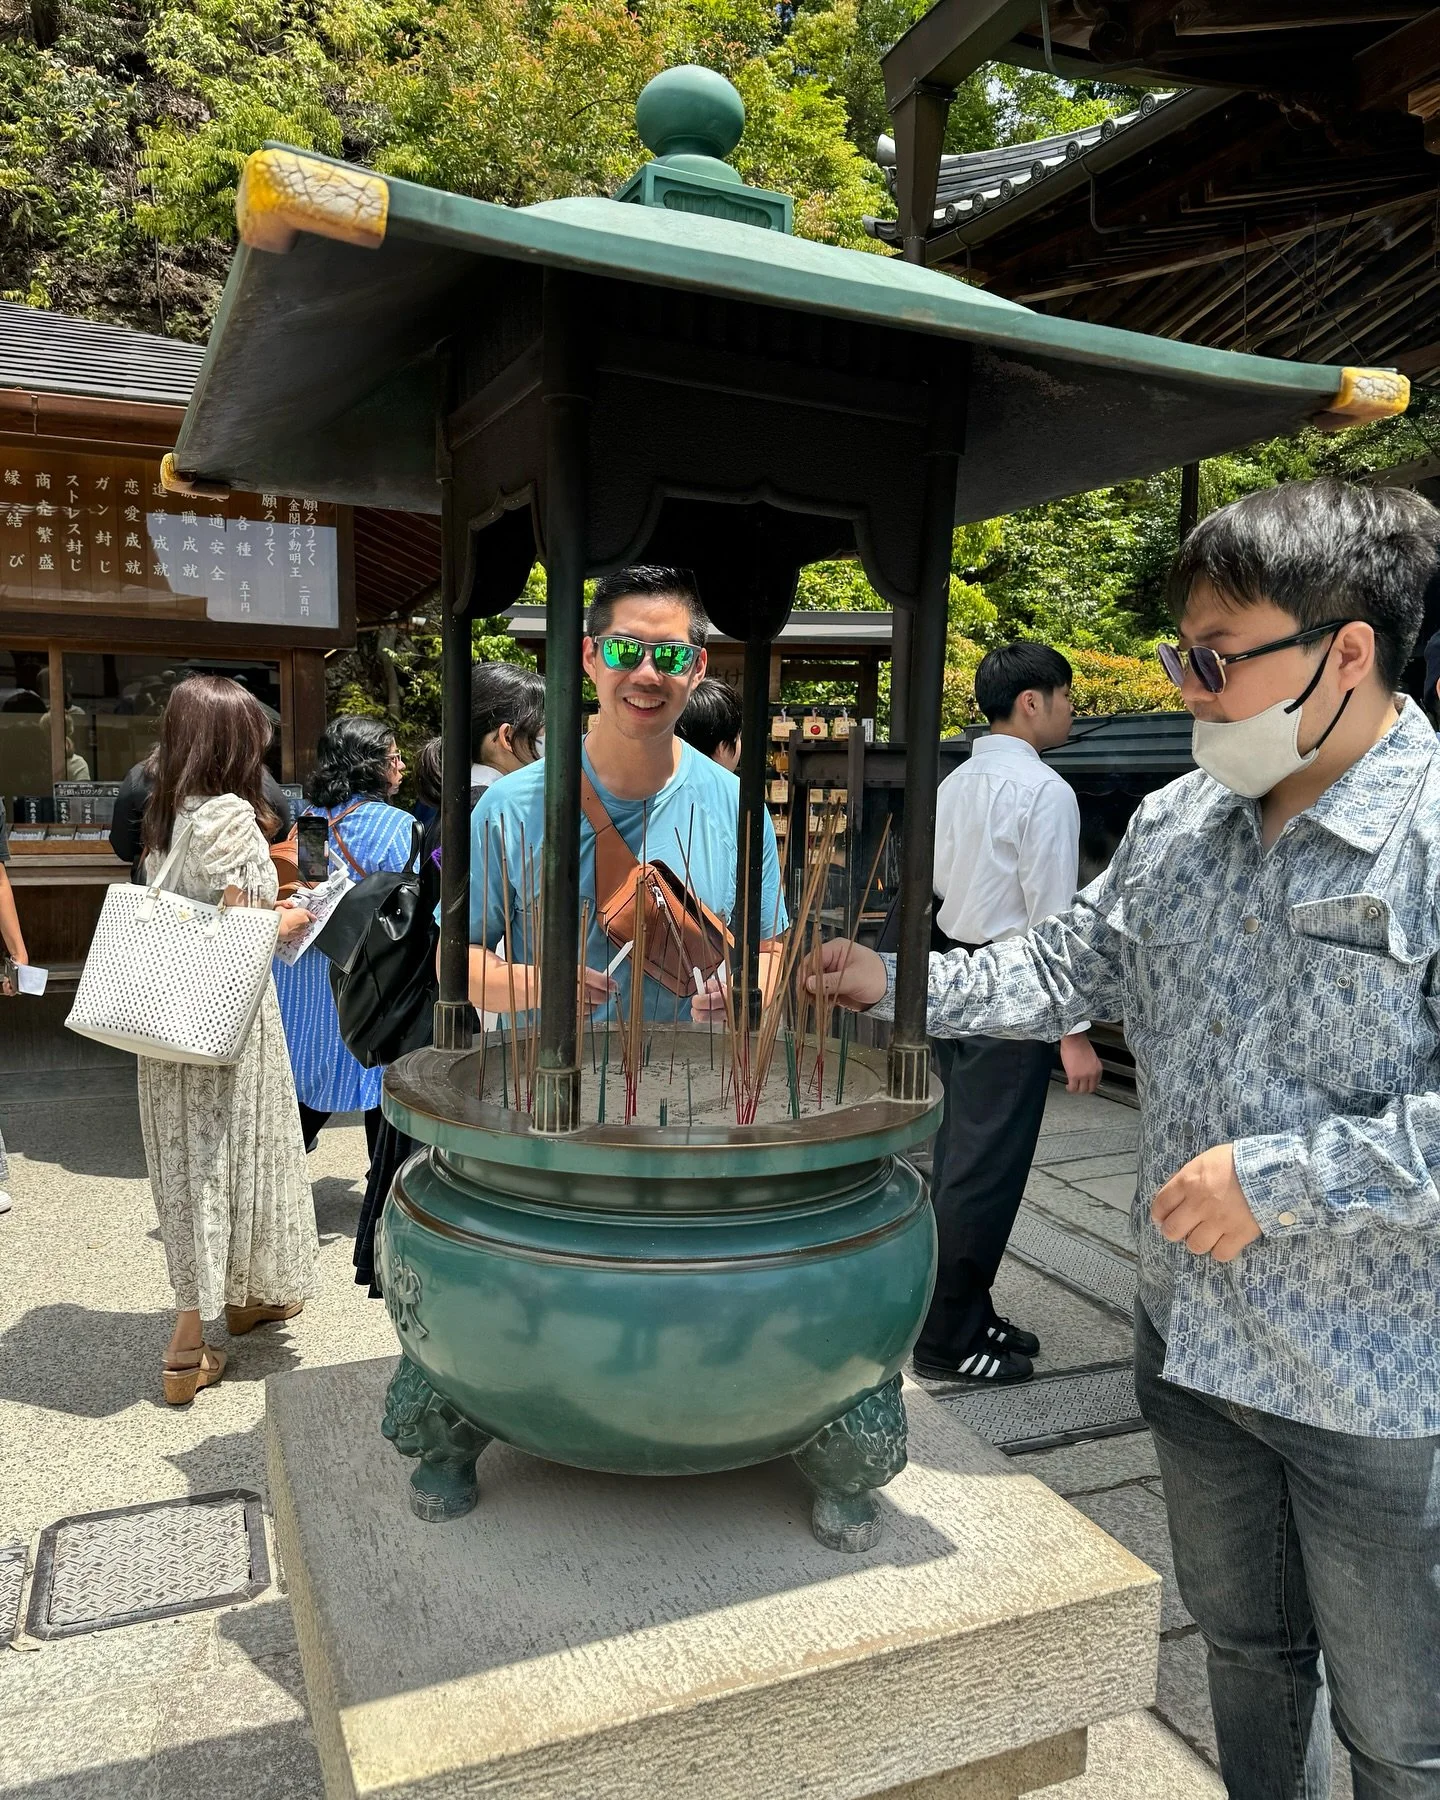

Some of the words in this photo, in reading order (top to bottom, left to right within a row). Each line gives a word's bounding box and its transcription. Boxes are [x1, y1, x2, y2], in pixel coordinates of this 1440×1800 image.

[4, 469, 25, 568] 縁結び
[35, 472, 54, 571] 商売繁盛
[66, 475, 84, 572] ストレス封じ
[95, 476, 113, 574] ガン封じ
[124, 478, 143, 575] 恋愛成就
[152, 483, 170, 577] 進学成就
[235, 515, 252, 557] 各種
[288, 498, 303, 578] 金閣不動明王
[239, 580, 251, 613] 五十円
[299, 585, 311, 617] 二百円
